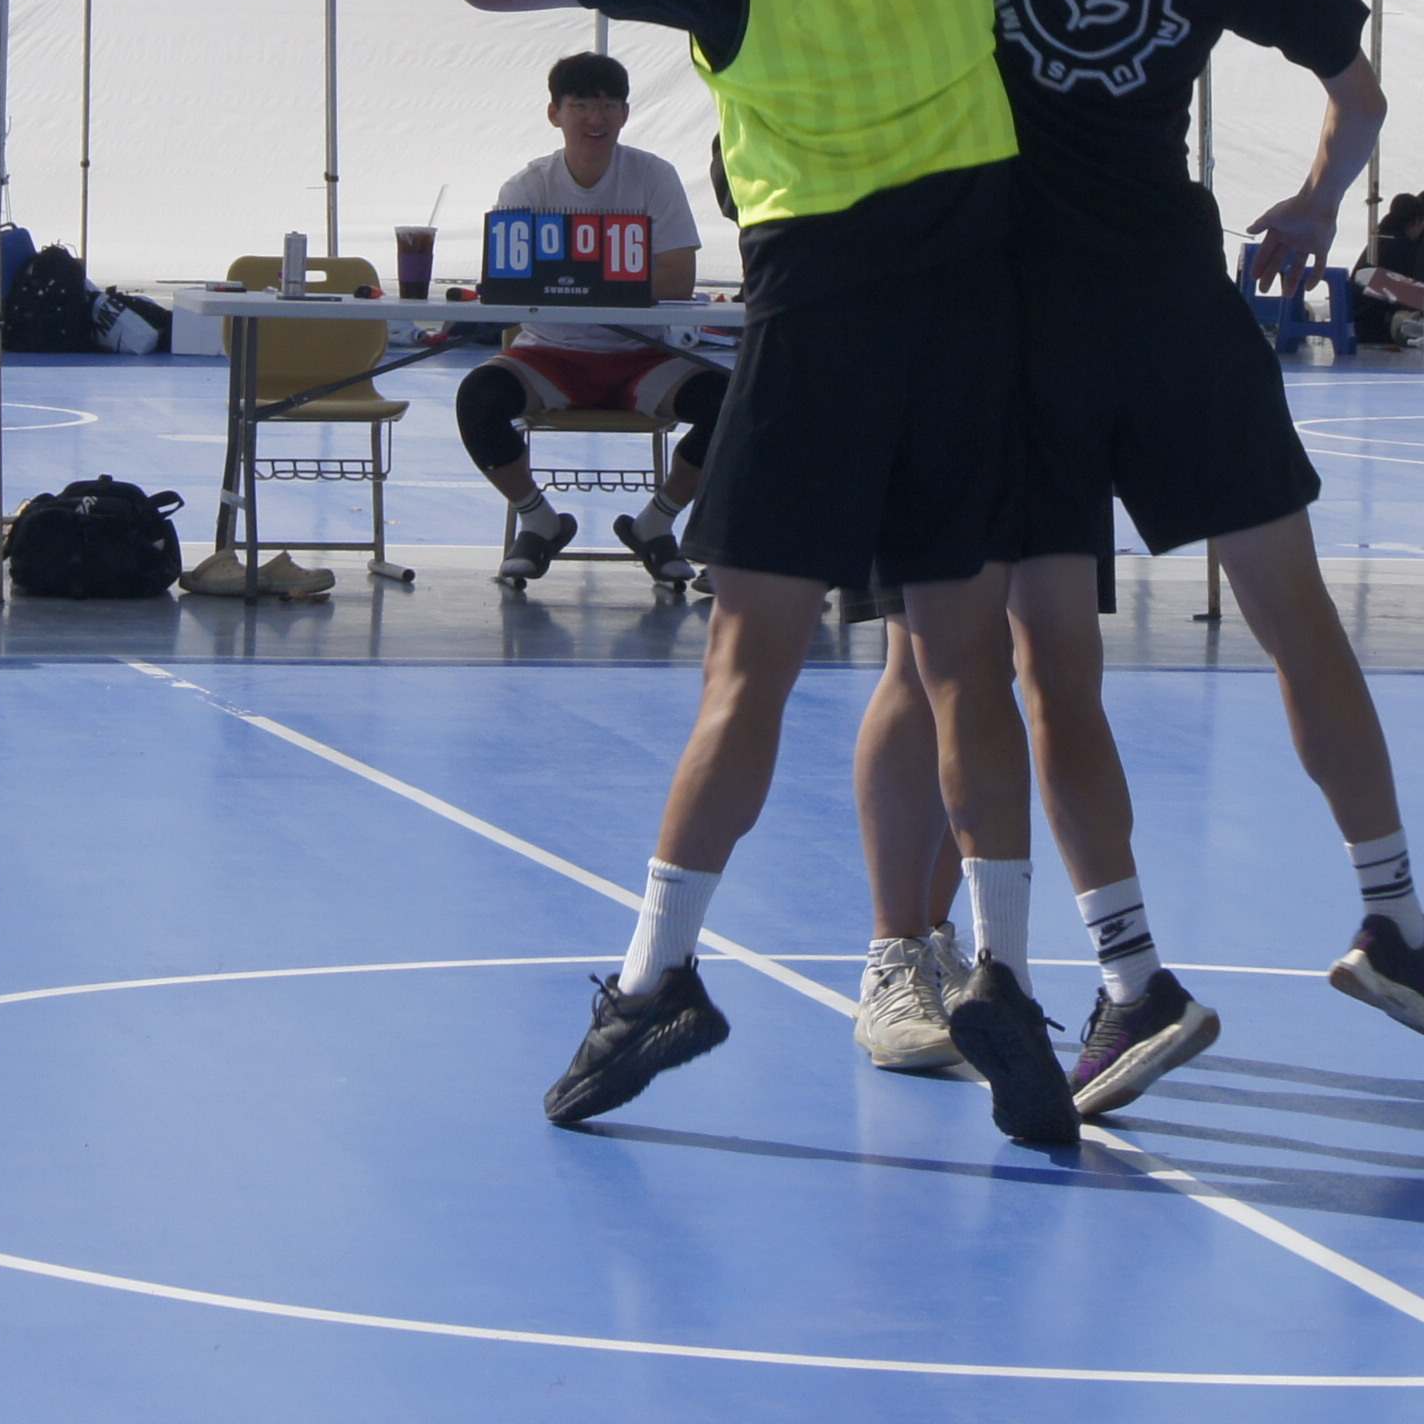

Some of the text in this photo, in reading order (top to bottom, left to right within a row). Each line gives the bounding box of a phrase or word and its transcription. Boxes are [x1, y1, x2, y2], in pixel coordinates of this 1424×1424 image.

[492, 221, 644, 273] 16 0 0 16
